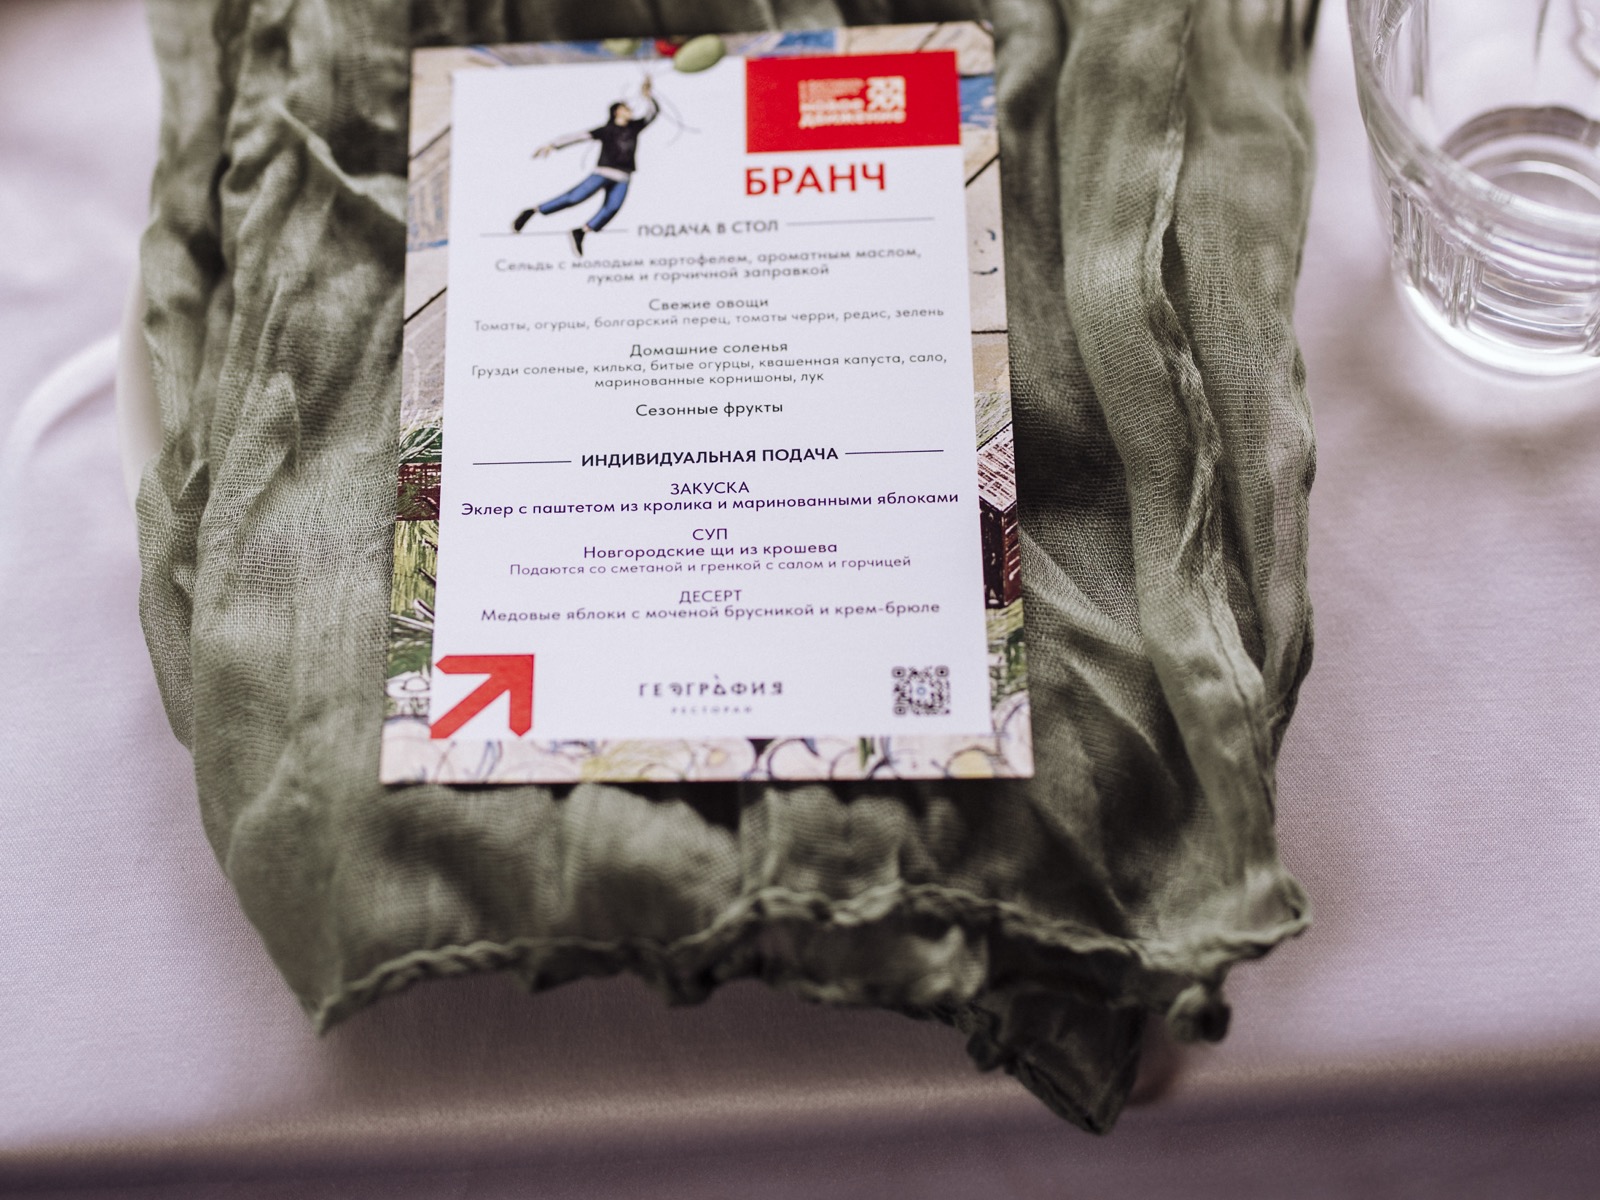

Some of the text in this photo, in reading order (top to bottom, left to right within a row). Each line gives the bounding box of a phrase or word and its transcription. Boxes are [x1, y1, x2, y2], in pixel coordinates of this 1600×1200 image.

[744, 162, 886, 197] БРАНЧ
[636, 219, 779, 239] ПОДАЧА В СТОЛ
[494, 248, 922, 272] Сельдь с молодым картофелем, ароматным маслом,
[586, 265, 830, 285] луком и горчичной заправкой
[647, 298, 769, 312] Свежие овощи
[474, 308, 945, 332] Томаты, огурцы, болгарский перец, томаты черри, редис, зелень
[628, 342, 789, 358] Домашние соленья
[471, 353, 948, 379] Грузди соленые, килька, битые огурцы, квашенная капуста, сало,
[594, 373, 825, 391] маринованные корнишоны, лук
[635, 401, 784, 418] Сезонные фрукты
[581, 447, 839, 468] ИНДИВИДУАЛЬНАЯ ПОДАЧА
[670, 481, 751, 496] ЗАКУСКА
[460, 491, 959, 519] Эклер с паштетом из кролика и маринованными яблоками
[691, 528, 728, 542] СУП
[583, 543, 838, 561] Новгородские щи из крошева
[509, 557, 912, 577] Подаются со сметаной и гренкой с салом и горчицей
[678, 589, 743, 604] ДЕСЕРТ
[480, 601, 941, 623] Медовые яблоки с моченой брусникой и крем-брюле
